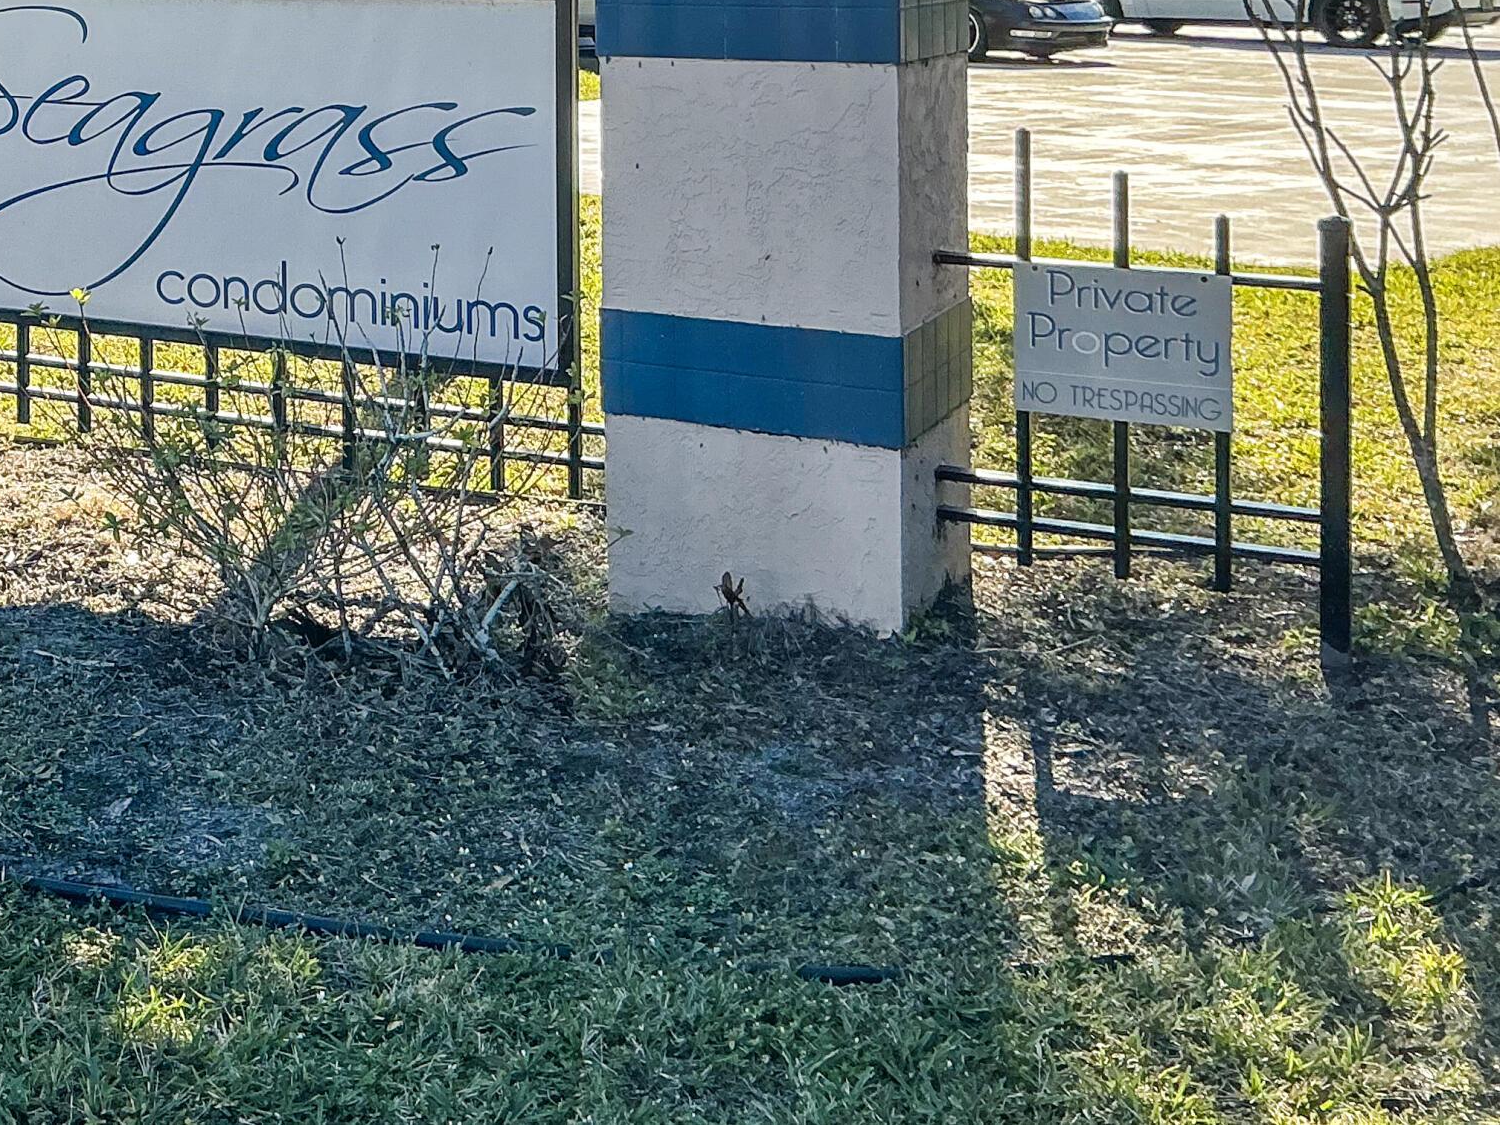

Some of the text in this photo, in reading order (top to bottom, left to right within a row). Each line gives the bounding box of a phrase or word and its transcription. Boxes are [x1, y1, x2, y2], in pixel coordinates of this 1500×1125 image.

[156, 261, 545, 342] condominiums
[1046, 270, 1197, 316] Private
[1027, 312, 1219, 376] Property
[1022, 381, 1222, 420] NO TRESPASSING
